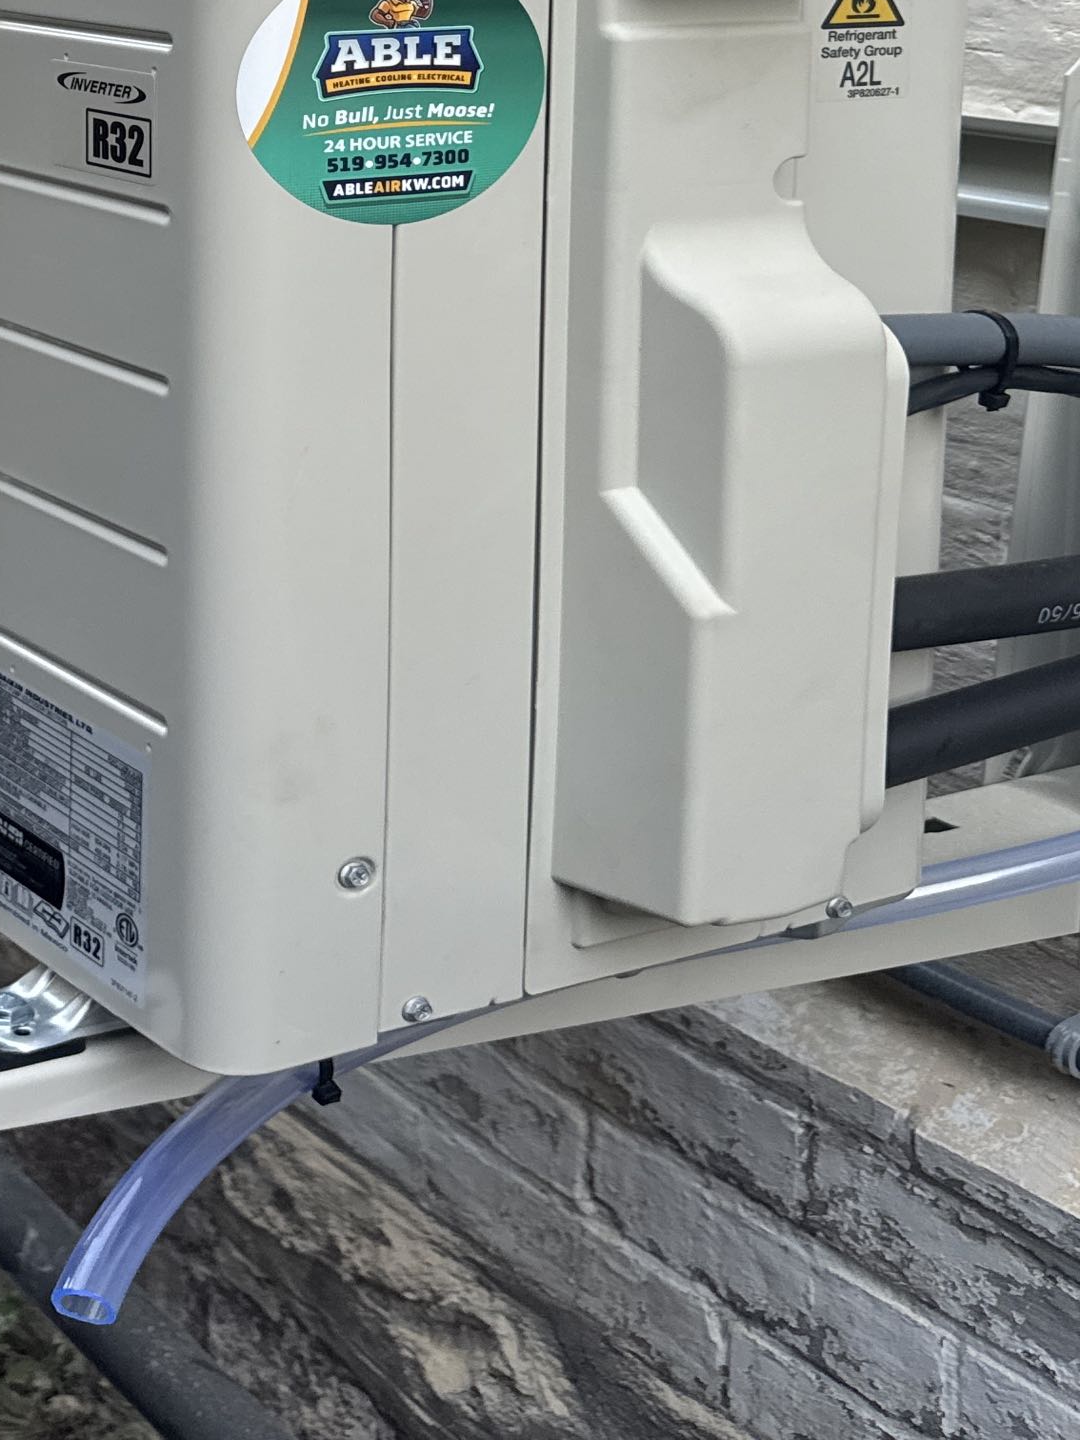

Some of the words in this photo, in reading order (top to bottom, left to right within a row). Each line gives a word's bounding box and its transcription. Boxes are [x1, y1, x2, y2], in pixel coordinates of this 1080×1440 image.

[828, 28, 897, 43] Refrigerant
[331, 34, 462, 73] ABLE
[821, 47, 861, 60] Safety
[864, 45, 903, 58] Group
[332, 75, 371, 89] HEATING
[375, 73, 412, 83] COOLING
[417, 73, 466, 82] ELECTRICAL
[839, 60, 882, 88] A2L
[70, 77, 132, 99] INVERTER
[302, 114, 329, 130] No
[335, 106, 379, 125] Bull,
[383, 104, 423, 121] Just
[427, 102, 495, 118] Moose!
[93, 117, 145, 168] R32
[323, 139, 345, 153] 24
[349, 135, 401, 152] HOUR
[405, 130, 473, 148] SERVICE
[332, 174, 465, 197] ABLEAIRKW.COM
[73, 923, 101, 960] R32
